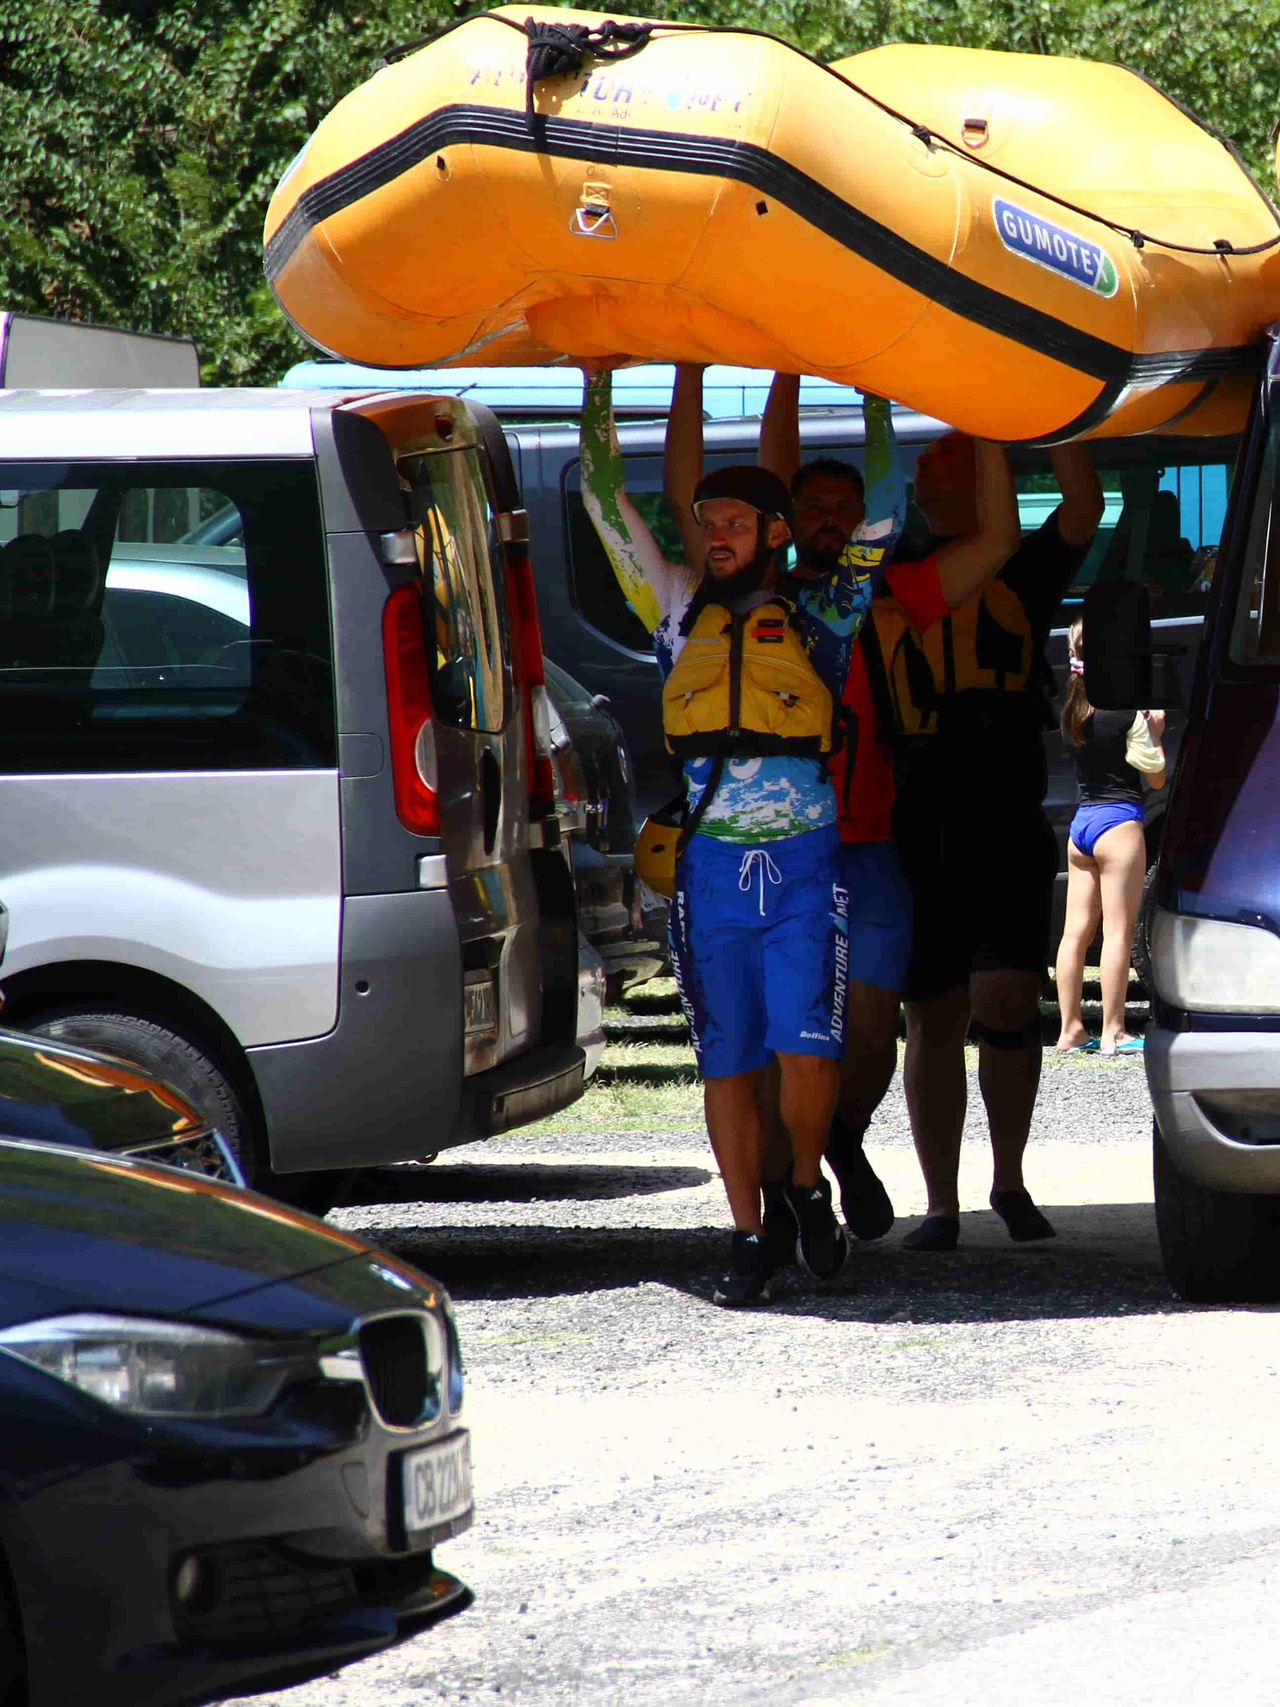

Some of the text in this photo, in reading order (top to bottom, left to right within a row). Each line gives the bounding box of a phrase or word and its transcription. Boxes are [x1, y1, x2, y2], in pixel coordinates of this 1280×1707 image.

[1002, 209, 1109, 285] GUMOTEX
[832, 883, 849, 1044] ADVENTURE NET
